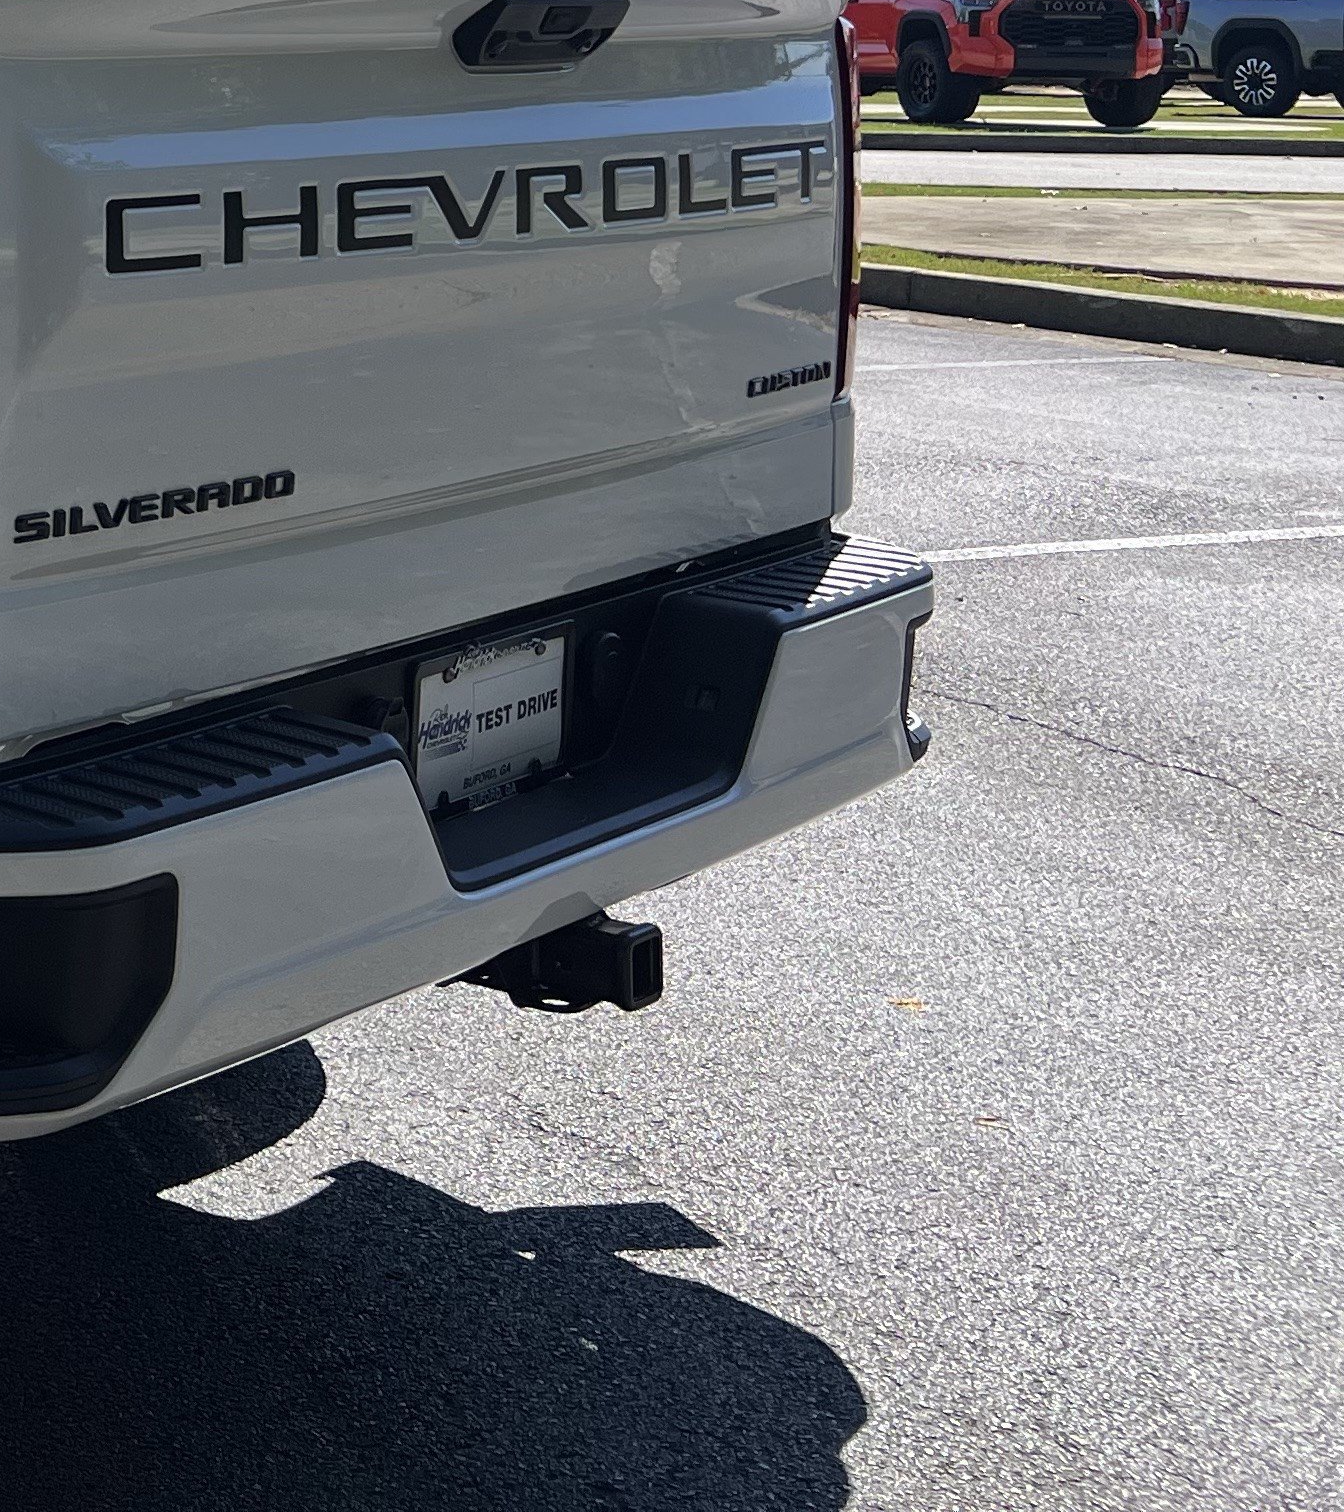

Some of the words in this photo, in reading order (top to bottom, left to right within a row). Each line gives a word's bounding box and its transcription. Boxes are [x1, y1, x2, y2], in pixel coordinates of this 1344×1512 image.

[1042, 0, 1107, 12] TOYOTA
[104, 139, 826, 275] CHEVROLET
[746, 360, 832, 399] CUSTOM
[13, 470, 296, 545] SILVERADO
[417, 708, 472, 749] Hendrick
[475, 703, 514, 734] TEST
[516, 688, 558, 721] DRIVE
[499, 761, 512, 776] GA
